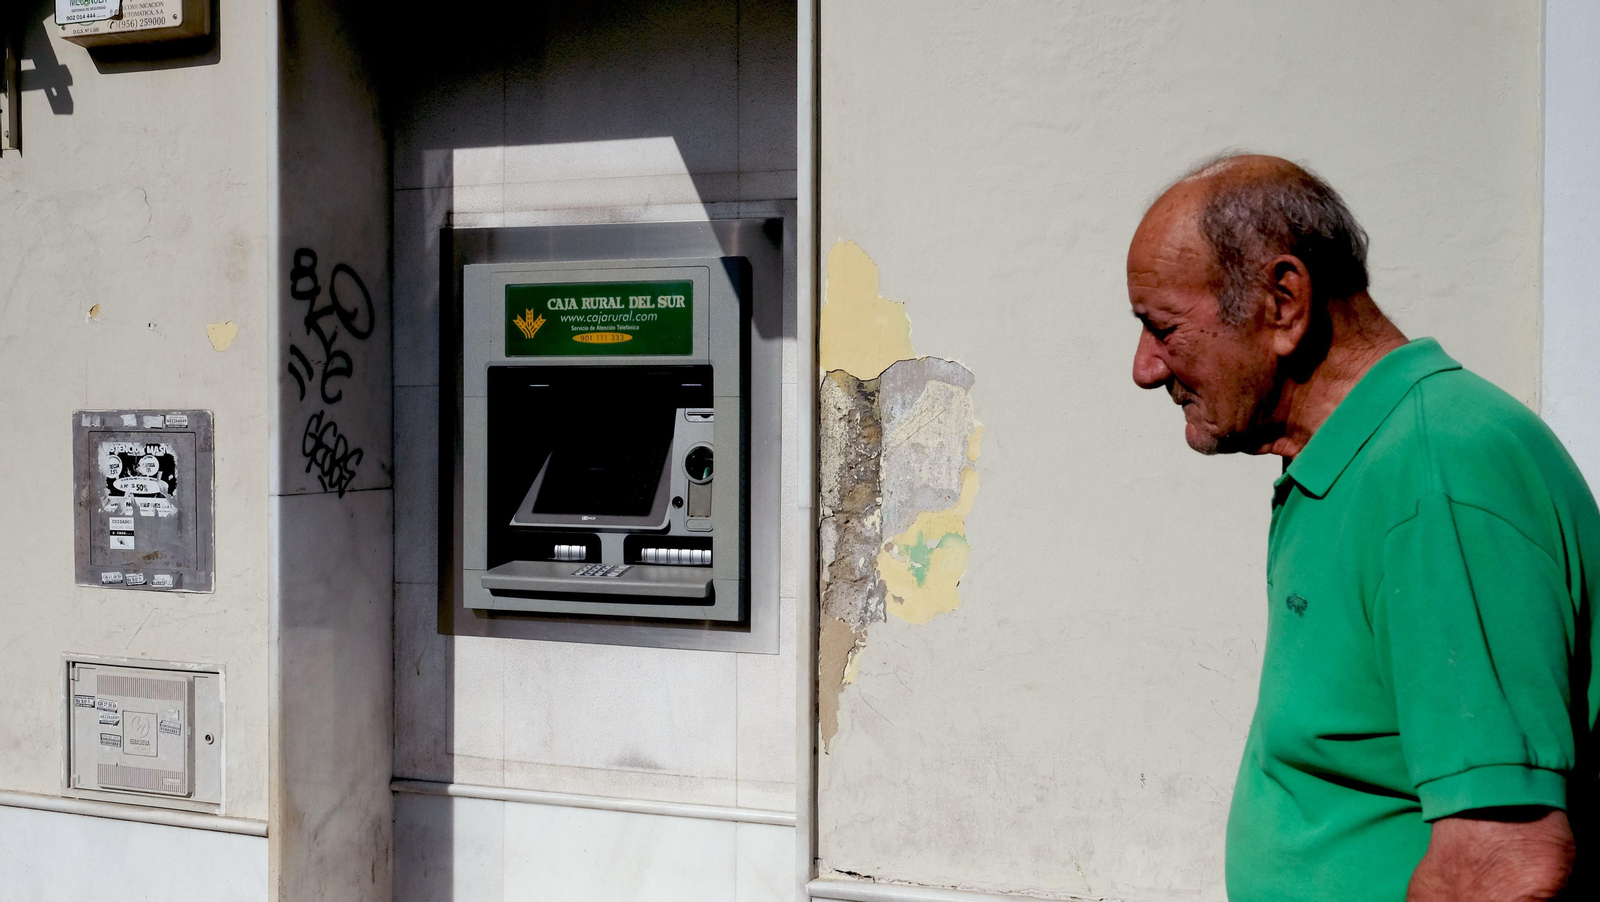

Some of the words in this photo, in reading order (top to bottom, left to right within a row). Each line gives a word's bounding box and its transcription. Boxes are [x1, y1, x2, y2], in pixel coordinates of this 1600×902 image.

[118, 18, 138, 29] (956)
[139, 17, 166, 27] 259000
[547, 297, 579, 310] CAJA
[581, 296, 625, 309] RURAL
[628, 295, 656, 309] DEL
[657, 295, 686, 308] SUR
[560, 310, 658, 324] www.cajarural.com
